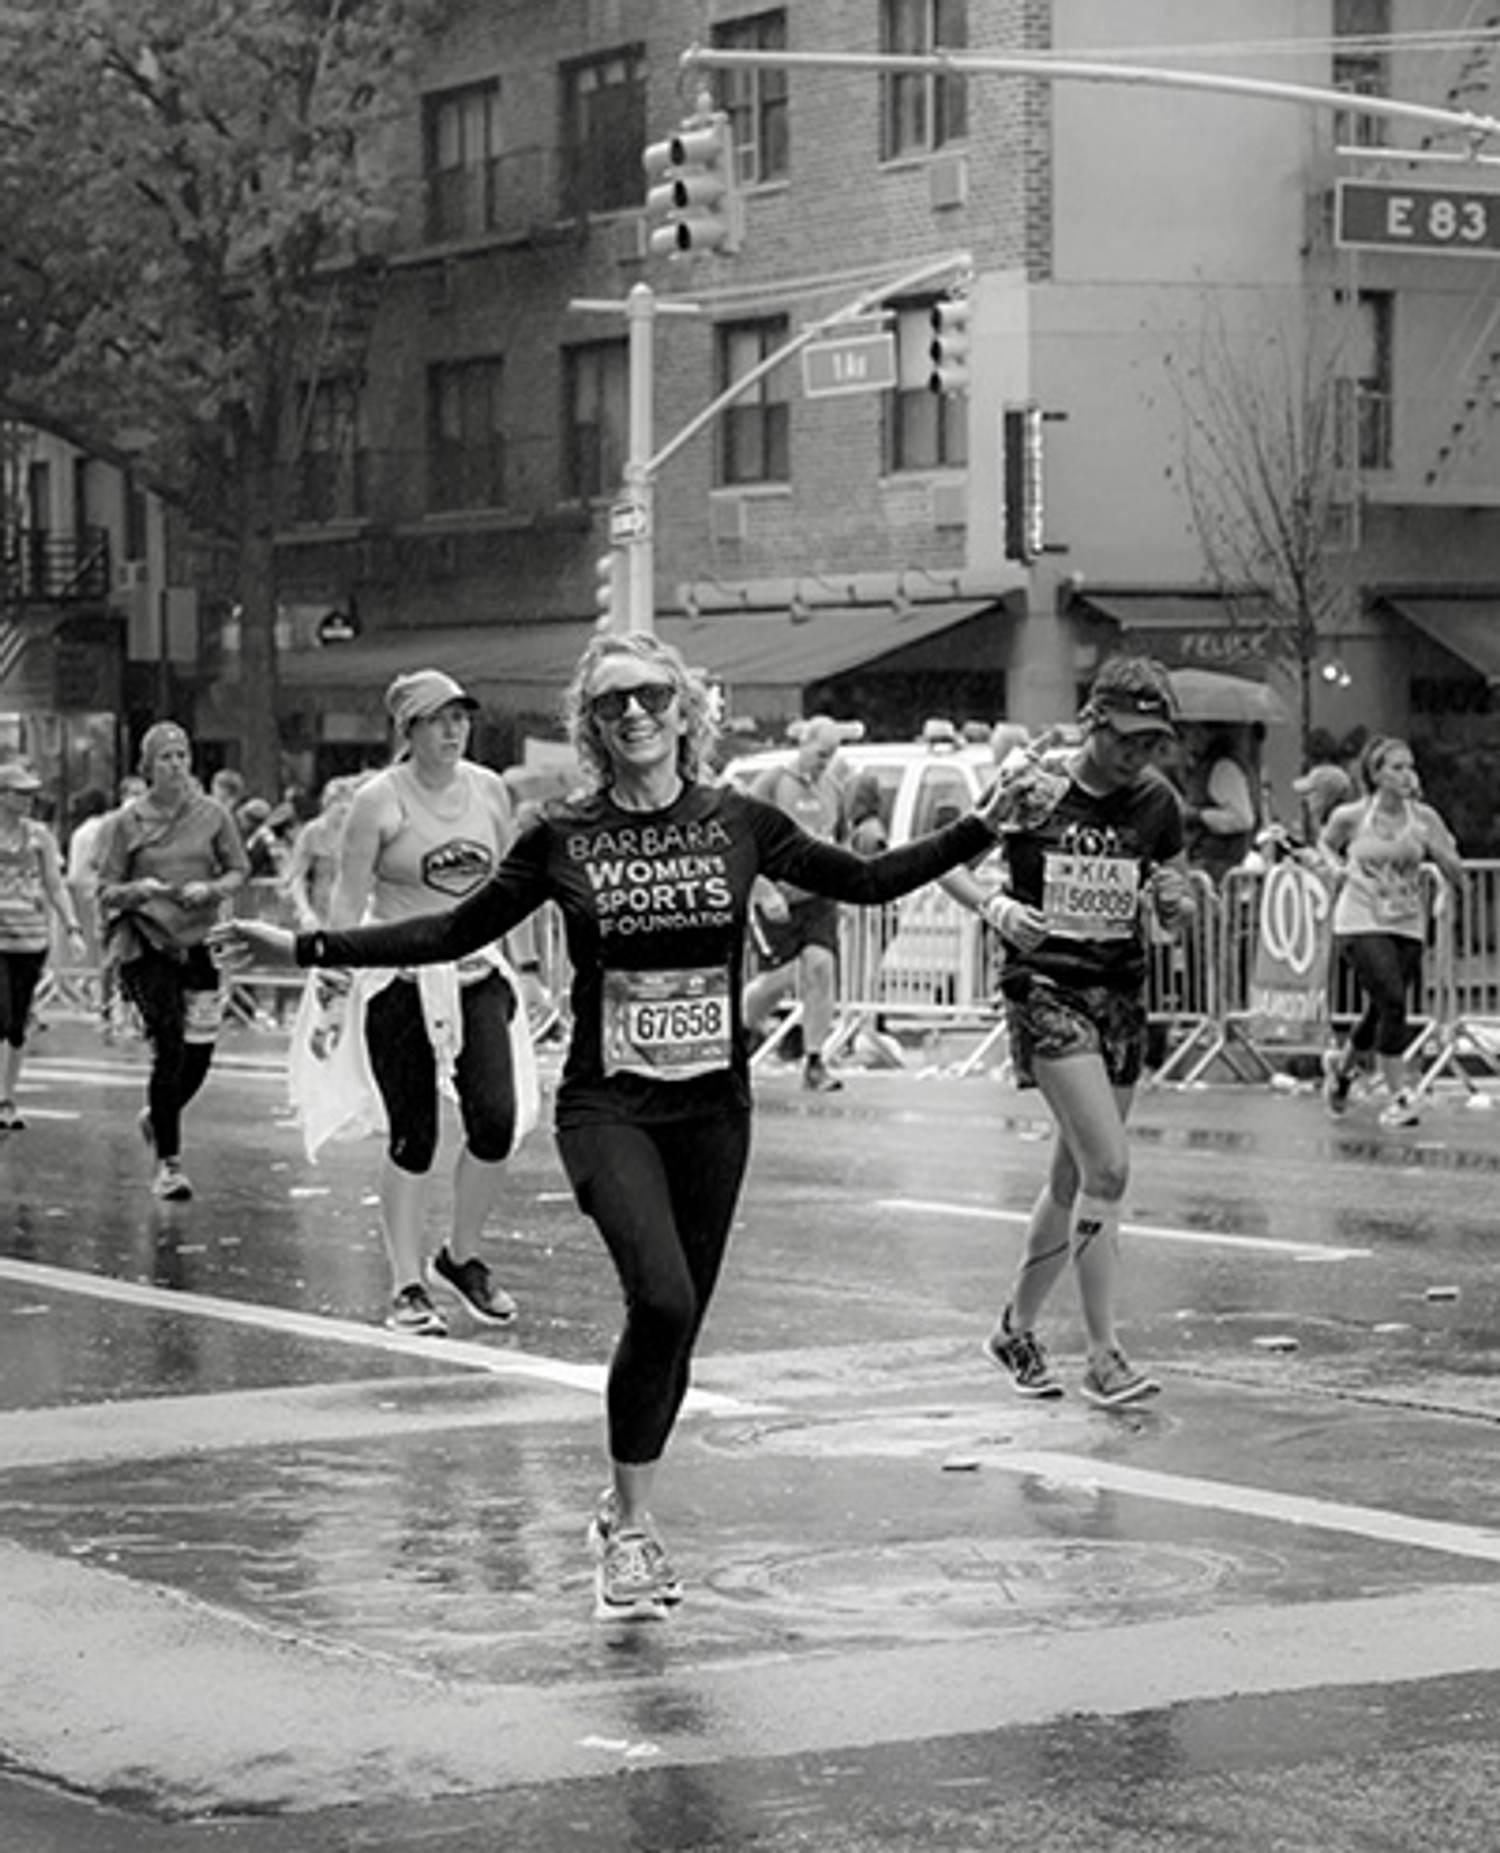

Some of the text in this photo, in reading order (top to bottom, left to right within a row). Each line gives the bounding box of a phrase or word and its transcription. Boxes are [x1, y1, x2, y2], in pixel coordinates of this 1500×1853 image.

[1386, 197, 1487, 241] E 83
[566, 820, 732, 861] BARBARA
[596, 876, 733, 914] SPORTS
[637, 1002, 722, 1040] 67658
